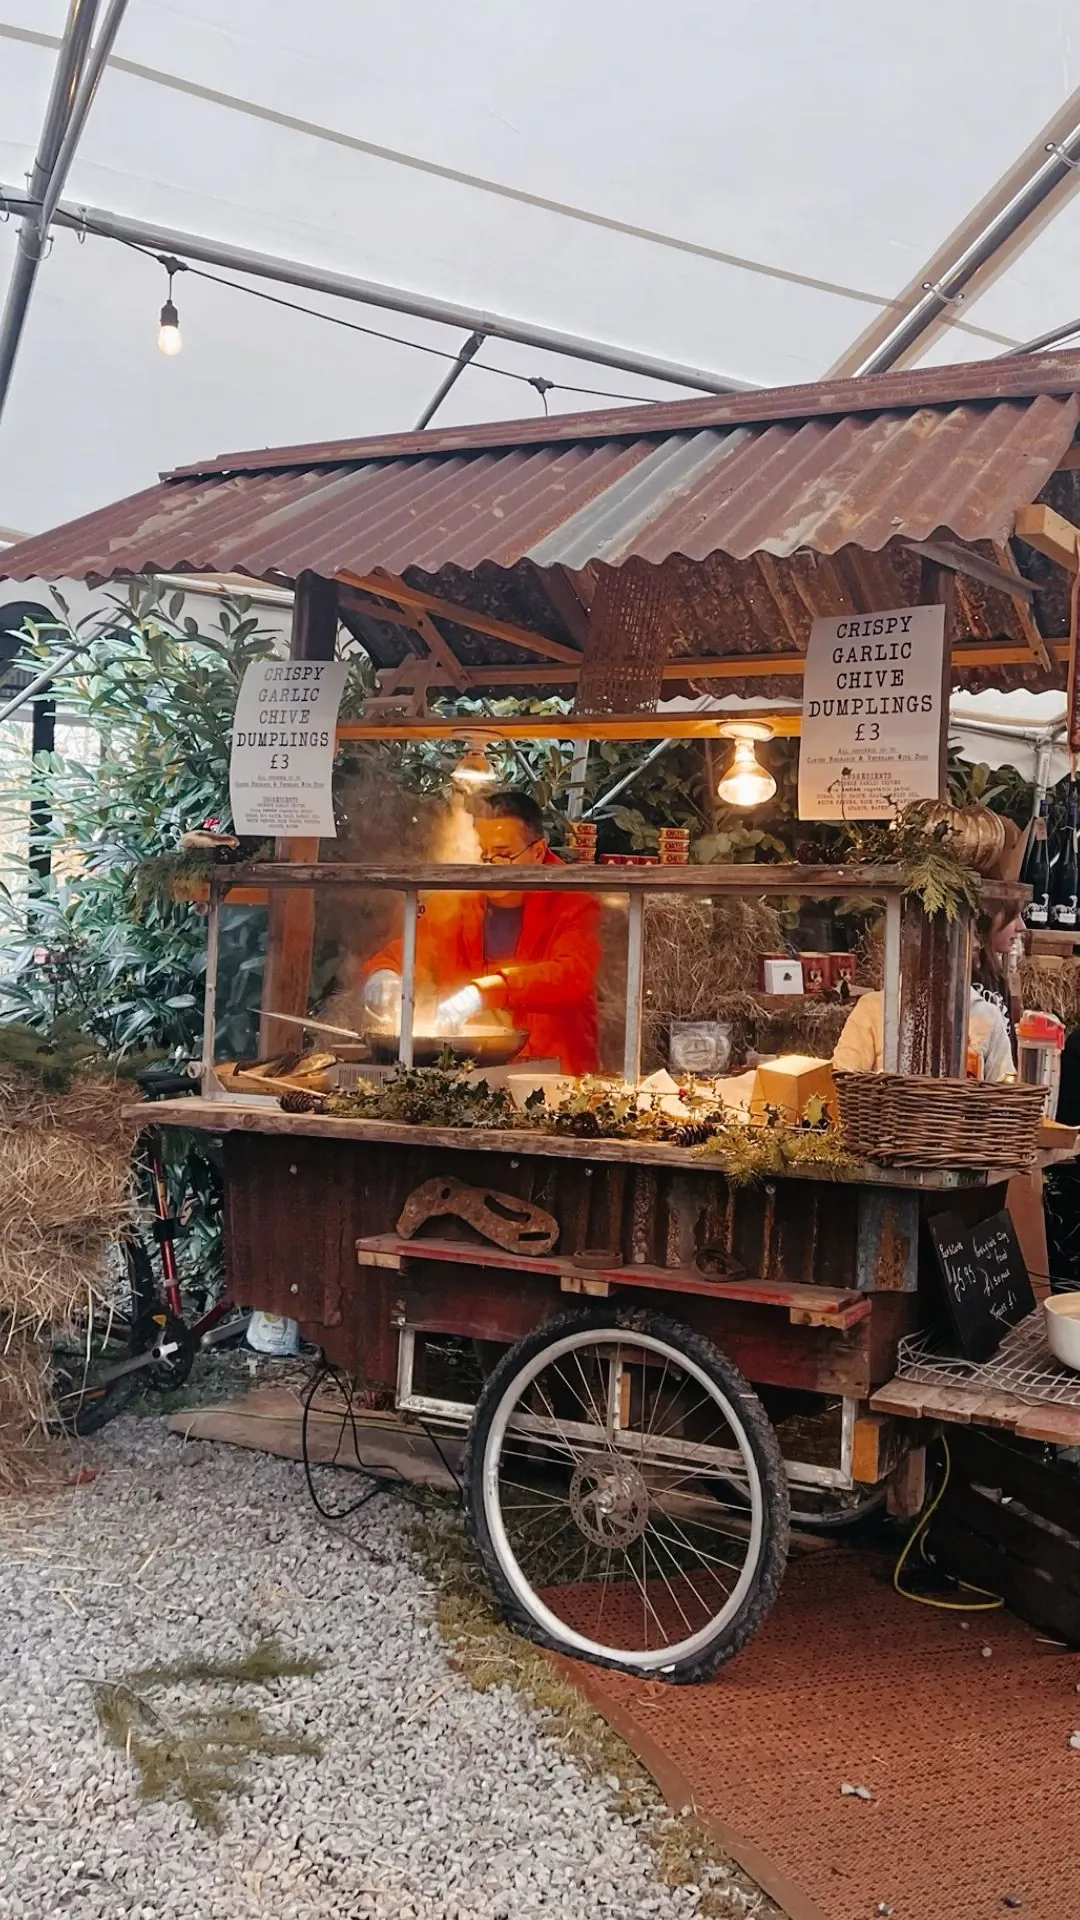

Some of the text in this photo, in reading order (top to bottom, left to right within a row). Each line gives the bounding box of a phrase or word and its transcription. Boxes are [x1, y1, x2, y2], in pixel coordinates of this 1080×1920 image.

[836, 616, 913, 639] CRISPY
[832, 642, 912, 664] GARLIC
[264, 667, 325, 681] CRISPY
[836, 669, 904, 690] CHIVE
[258, 688, 320, 702] GARLIC
[808, 695, 933, 718] DUMPLINGS
[259, 710, 310, 725] CHIVE
[236, 732, 329, 747] DUMPLINGS
[854, 723, 880, 741] £3
[270, 754, 289, 769] £3
